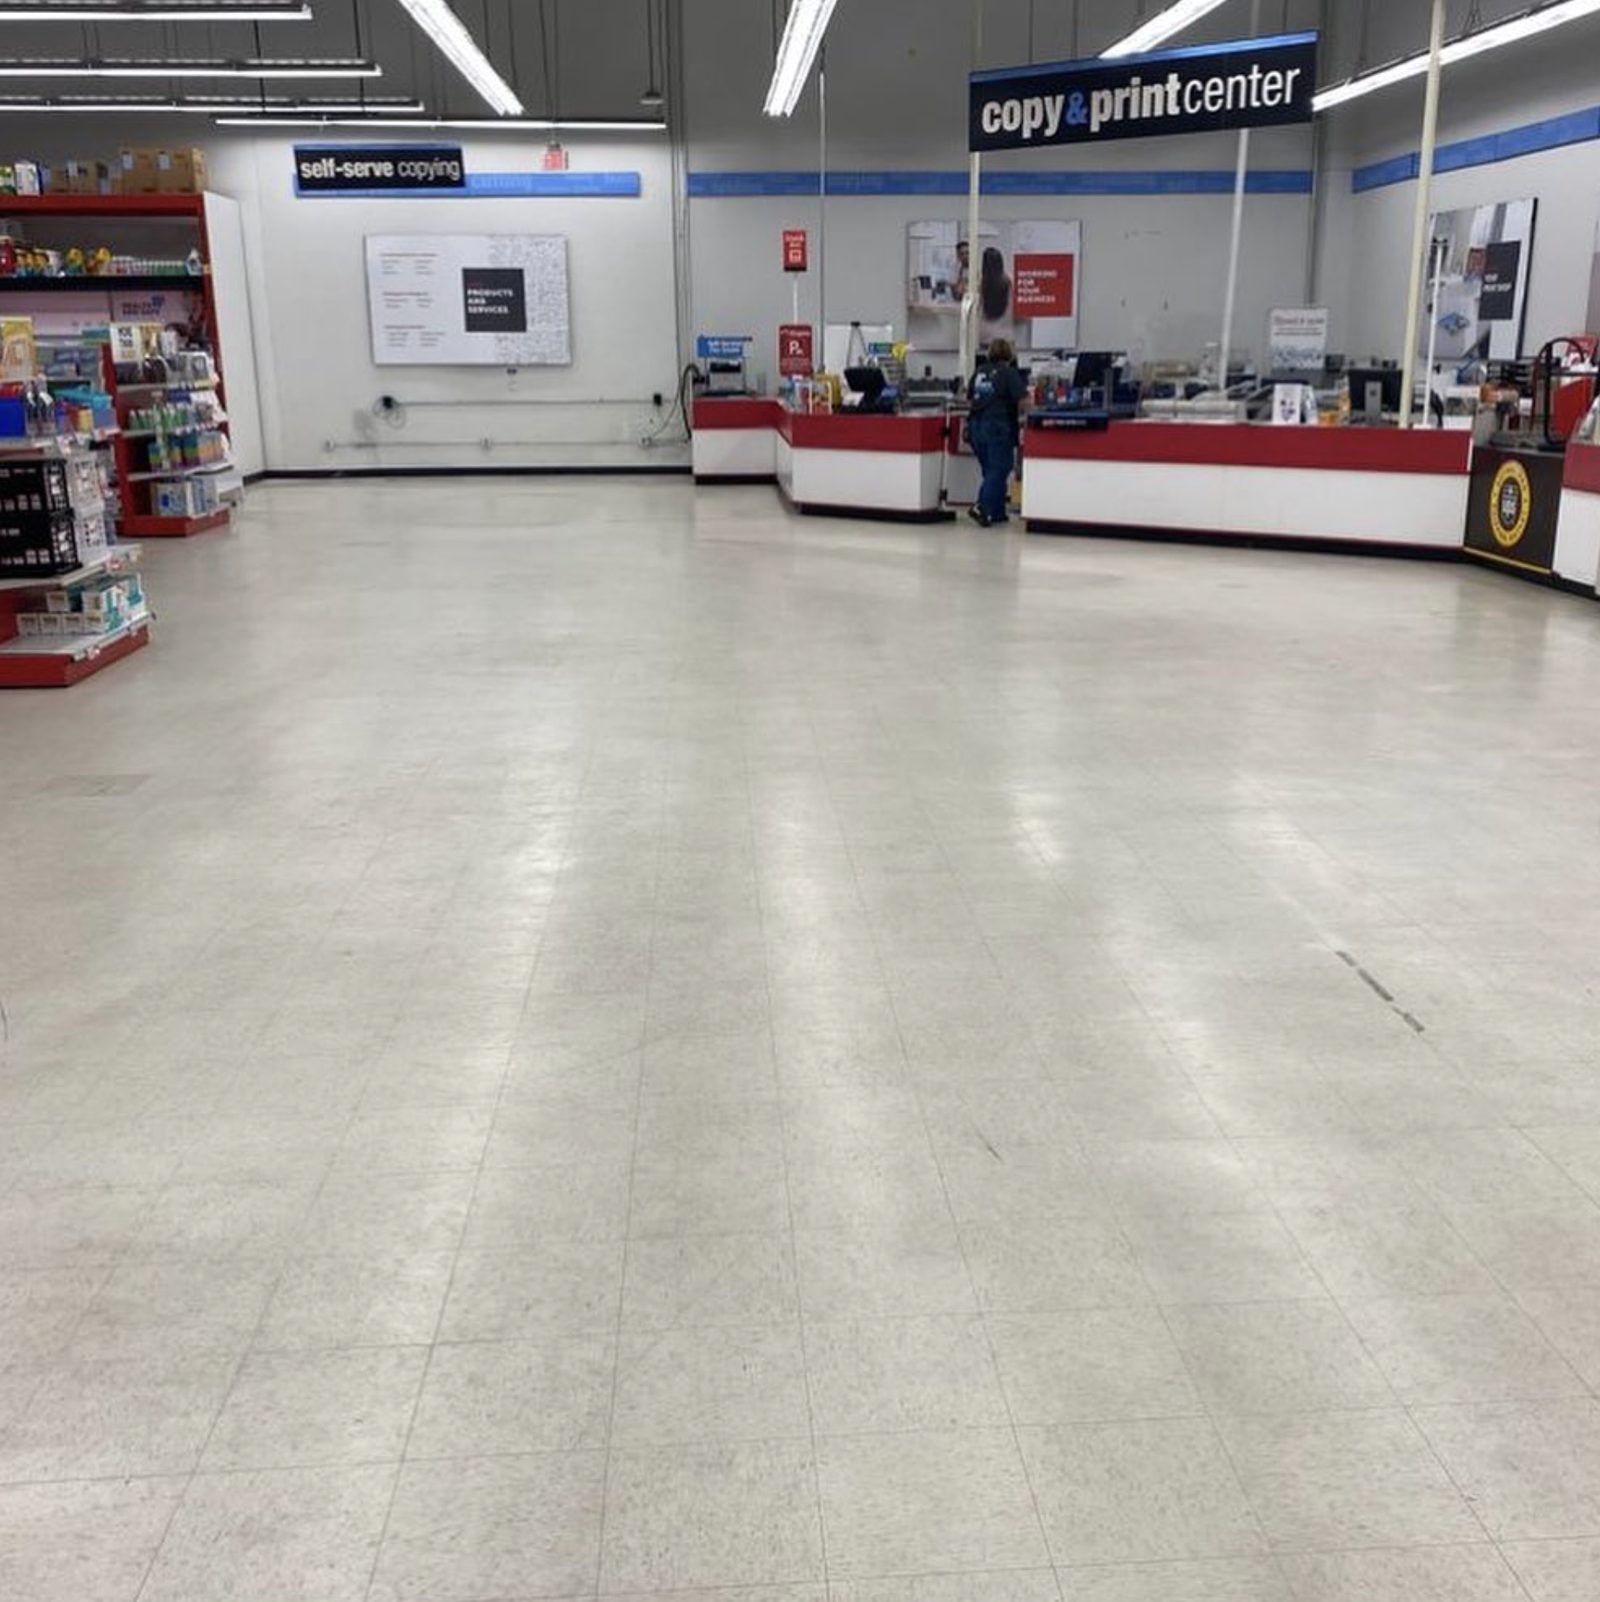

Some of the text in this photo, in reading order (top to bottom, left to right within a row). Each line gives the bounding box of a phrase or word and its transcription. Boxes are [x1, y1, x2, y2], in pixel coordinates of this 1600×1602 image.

[300, 158, 461, 181] self-serve copying
[467, 288, 514, 298] PRODUCTS
[467, 305, 510, 314] SERVICES
